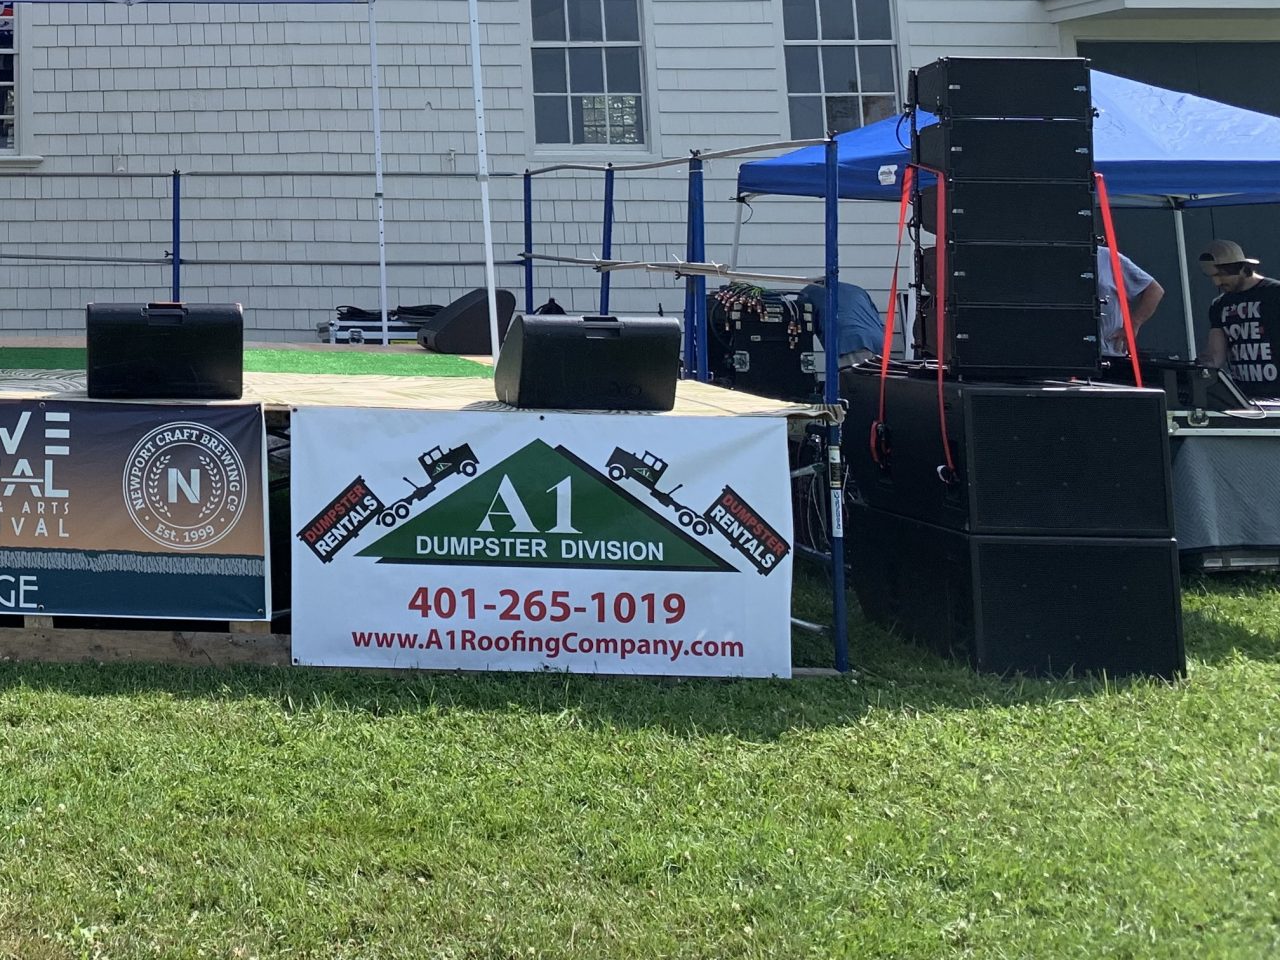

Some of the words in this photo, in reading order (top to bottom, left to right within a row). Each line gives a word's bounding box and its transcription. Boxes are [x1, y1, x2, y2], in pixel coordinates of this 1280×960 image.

[130, 441, 156, 511] NEWPORT
[155, 428, 200, 446] CRAFT
[200, 433, 241, 492] BREWING
[168, 467, 200, 504] N
[22, 501, 69, 515] ARTS
[303, 483, 366, 544] DUMPSTER
[314, 493, 380, 556] RENTALS
[476, 473, 583, 534] A1
[719, 490, 786, 556] DUMPSTER
[155, 524, 179, 542] Est.
[183, 525, 215, 543] 1999
[415, 535, 548, 559] DUMPSTER
[560, 538, 665, 562] DIVISION
[708, 504, 777, 571] RENTALS
[408, 586, 687, 625] 401-265-1019
[352, 627, 745, 662] www.A1RoofingCompany.com
